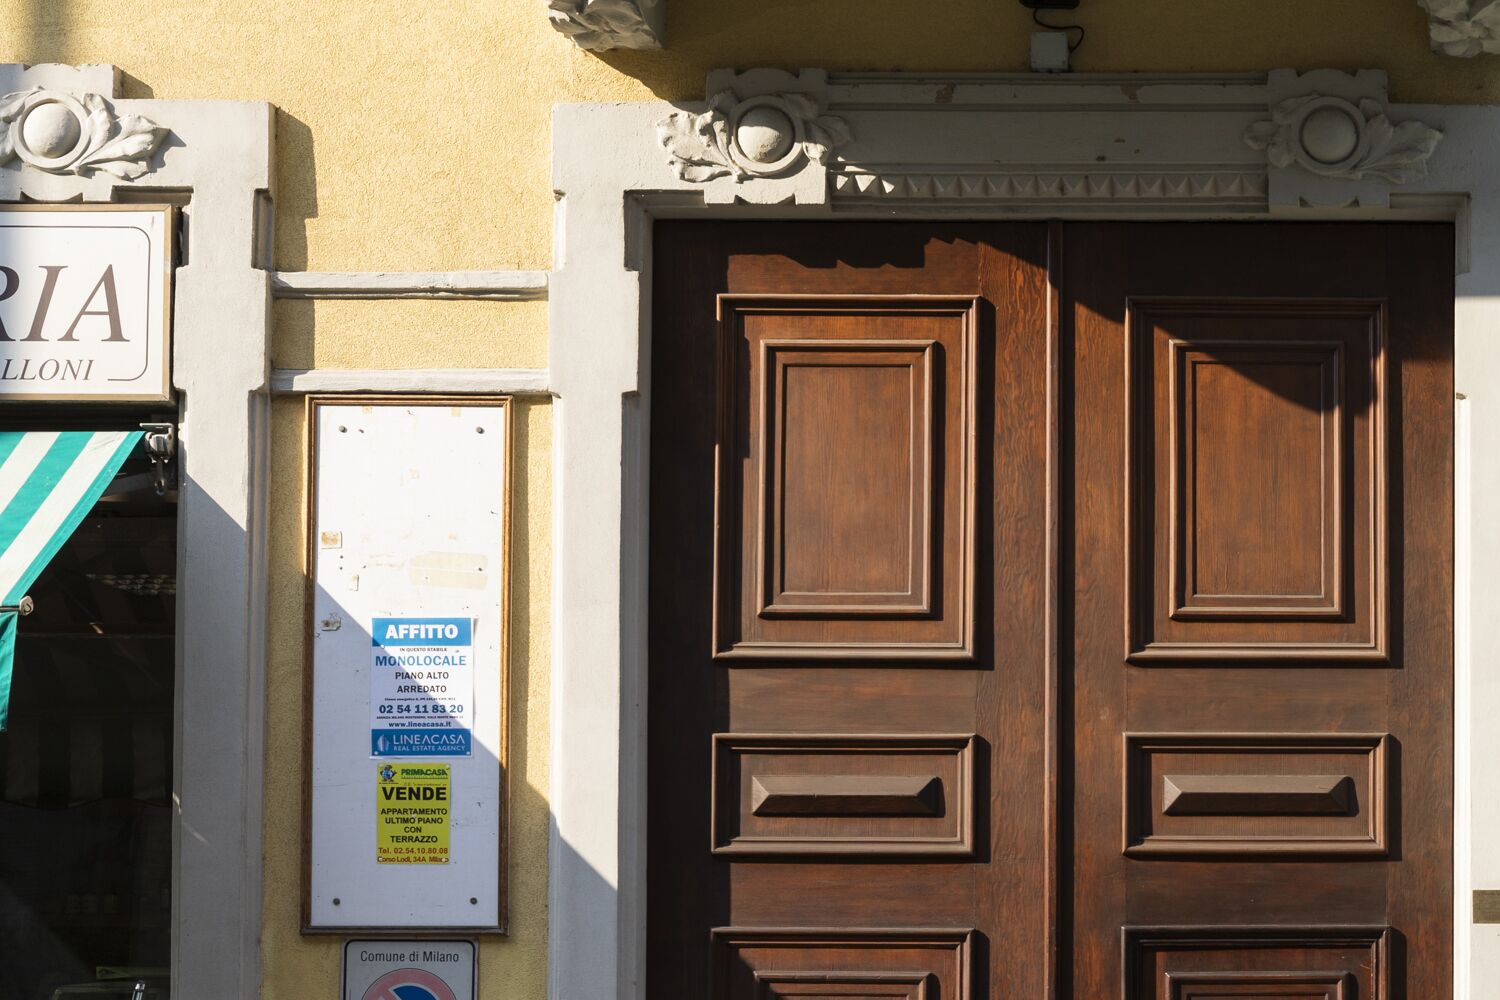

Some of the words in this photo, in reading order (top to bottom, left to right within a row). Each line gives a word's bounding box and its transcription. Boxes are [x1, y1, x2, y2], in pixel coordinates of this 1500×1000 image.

[385, 624, 459, 639] AFFITTO
[375, 655, 467, 667] MONOLOCALE
[395, 671, 424, 680] PIANO
[426, 671, 449, 680] ALTO
[397, 685, 447, 693] ARREDATO
[379, 704, 394, 714] 02
[396, 704, 411, 714] 54
[414, 704, 429, 714] 11
[432, 704, 446, 714] 83
[449, 704, 464, 714] 20
[388, 720, 452, 728] www.lineacasa.it
[393, 734, 465, 745] LINEACASA
[401, 768, 448, 776] PRIMACASA
[381, 787, 447, 800] VENDE
[360, 950, 406, 963] Comune
[408, 950, 420, 963] di
[422, 950, 460, 963] Milano
